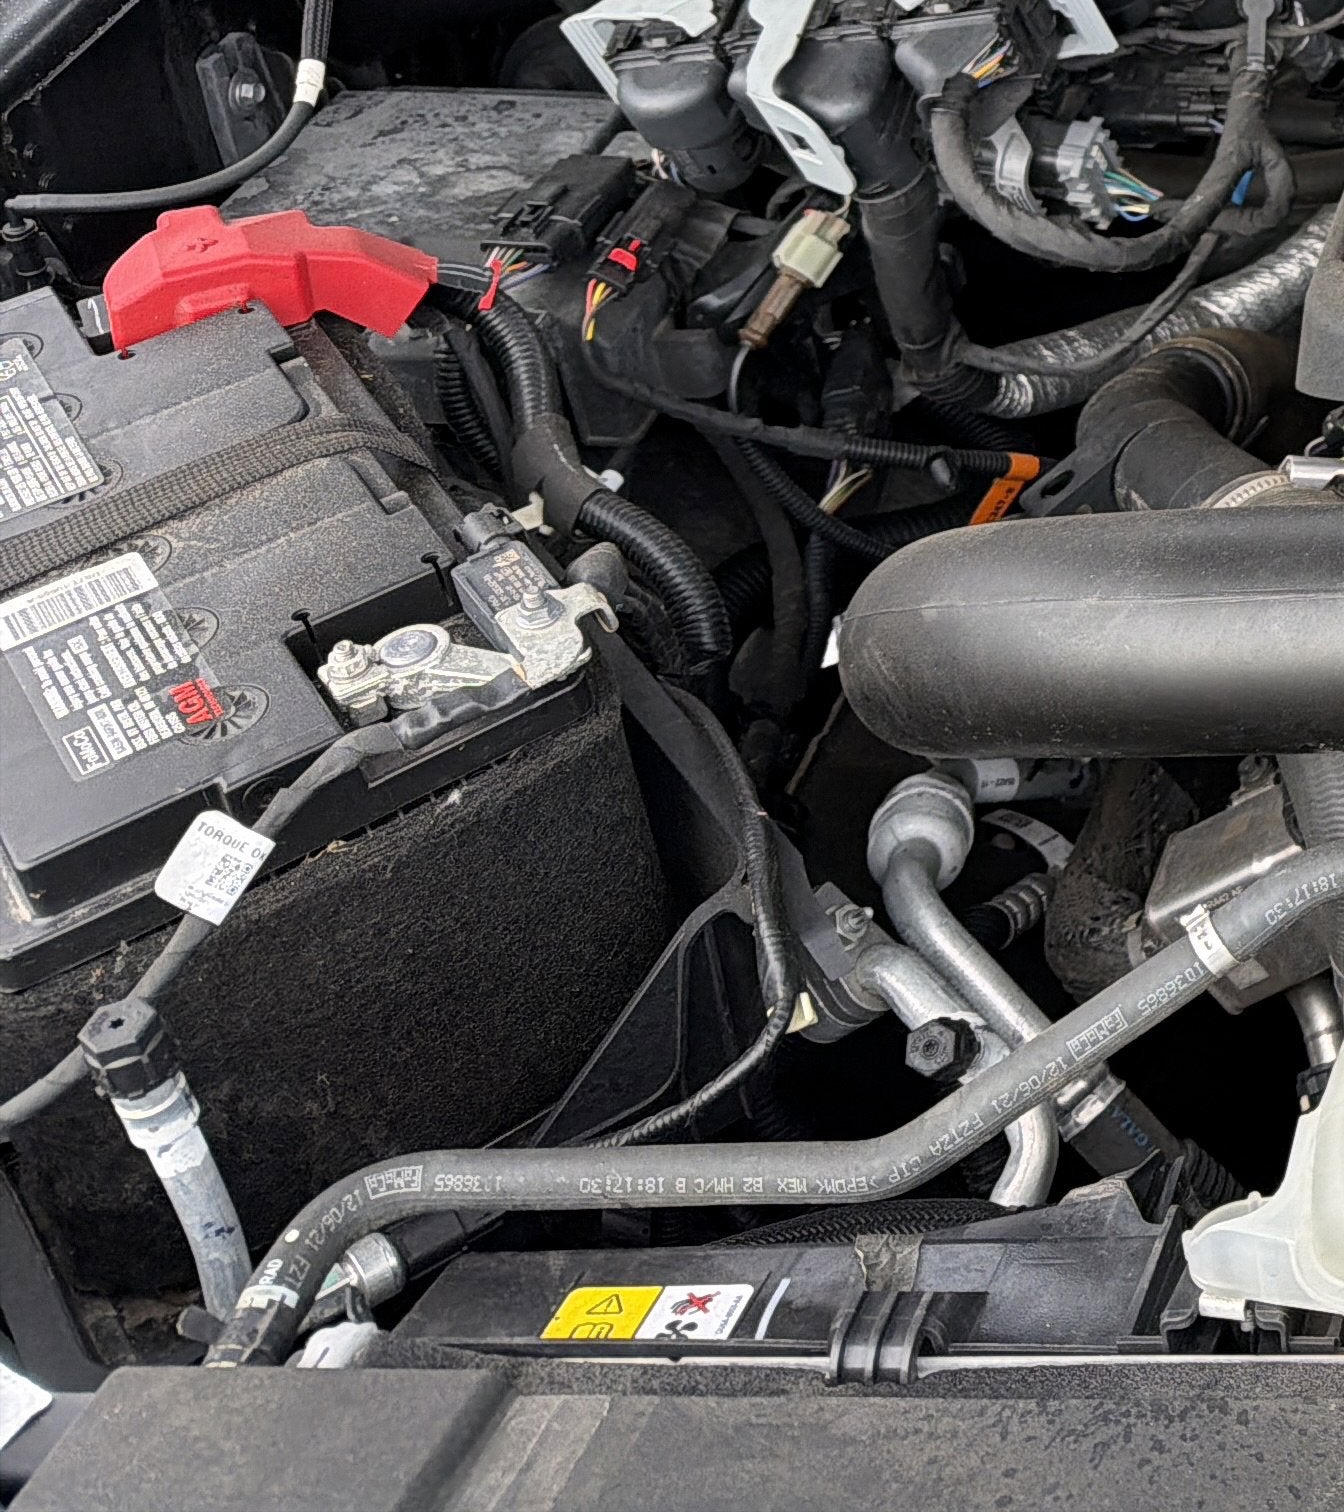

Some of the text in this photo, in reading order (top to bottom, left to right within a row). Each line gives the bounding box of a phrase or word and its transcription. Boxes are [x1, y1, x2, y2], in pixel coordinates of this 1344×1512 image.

[169, 681, 213, 725] AGM
[74, 732, 102, 768] FoMoCo
[197, 822, 266, 861] TORQUE OK
[1263, 869, 1338, 926] 18:17:30
[1068, 1011, 1126, 1057] FoMoCo
[990, 1056, 1068, 1110] 12/06/21
[367, 1169, 419, 1193] FoMoCo
[579, 1176, 665, 1194] 18:17:30
[675, 1178, 686, 1194] B
[694, 1178, 733, 1194] HM/C
[742, 1178, 763, 1194] B2
[776, 1178, 807, 1194] MEX
[304, 1189, 363, 1251] 12/06/21
[258, 1259, 283, 1286] RAD
